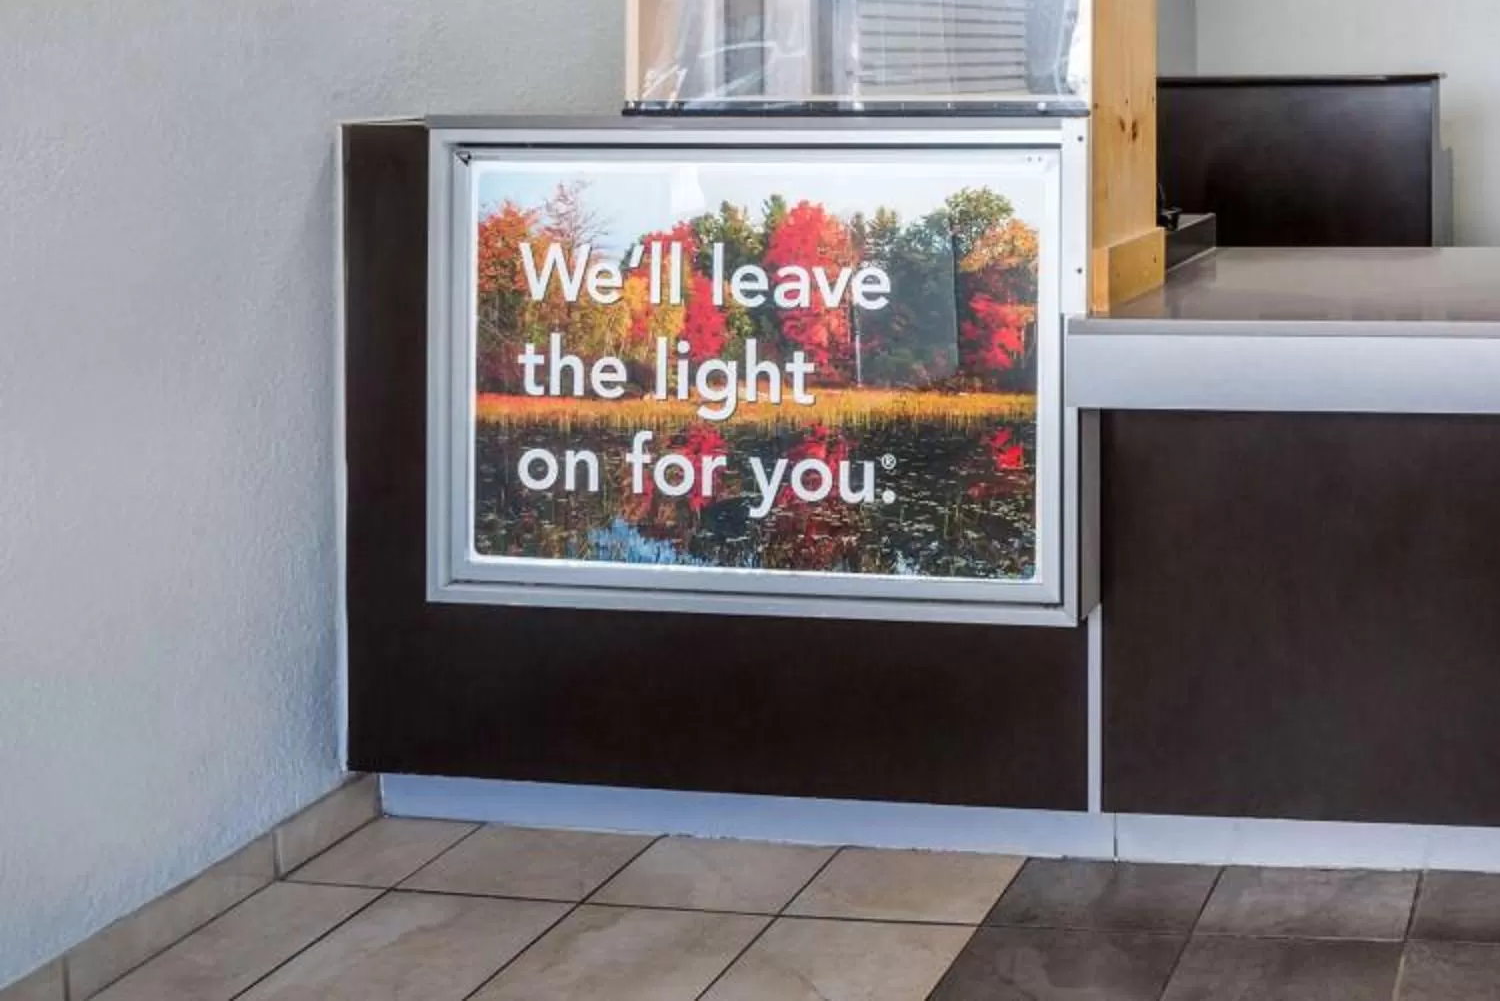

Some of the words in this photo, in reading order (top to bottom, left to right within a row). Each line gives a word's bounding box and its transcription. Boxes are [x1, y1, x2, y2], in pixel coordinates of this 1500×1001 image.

[520, 241, 682, 303] We'll
[713, 243, 891, 309] leave
[518, 334, 627, 398] the
[657, 337, 815, 421] light
[518, 448, 598, 492] on
[626, 431, 727, 498] for
